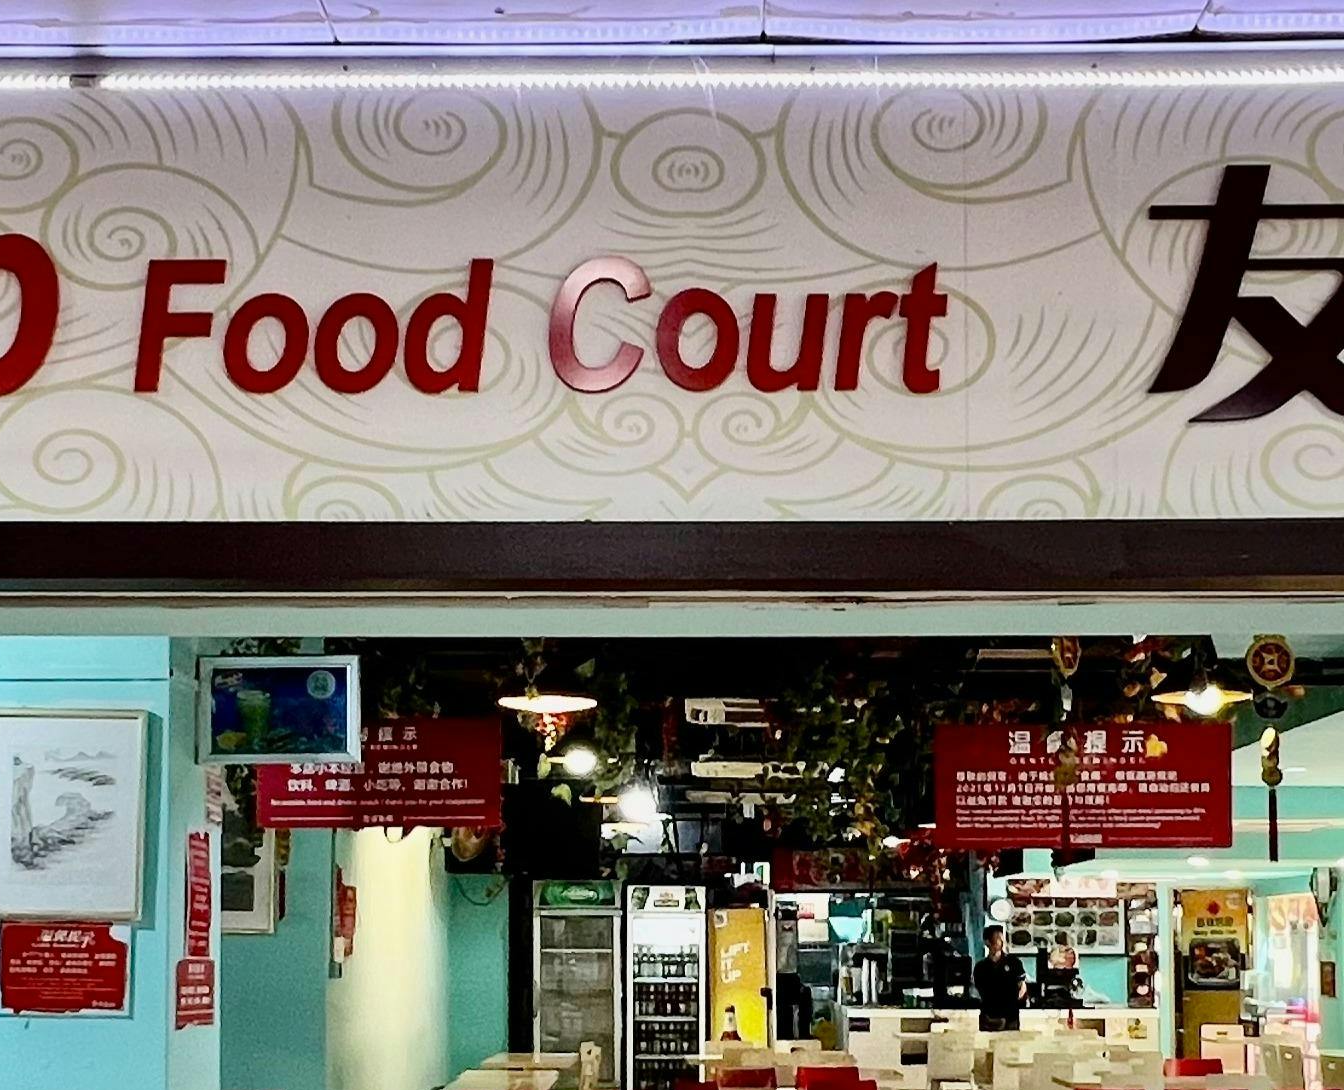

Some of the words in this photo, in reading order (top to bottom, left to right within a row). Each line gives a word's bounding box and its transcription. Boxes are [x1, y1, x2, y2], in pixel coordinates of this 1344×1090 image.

[134, 258, 493, 395] Food
[547, 254, 948, 395] Court
[1009, 757, 1056, 765] GENTL
